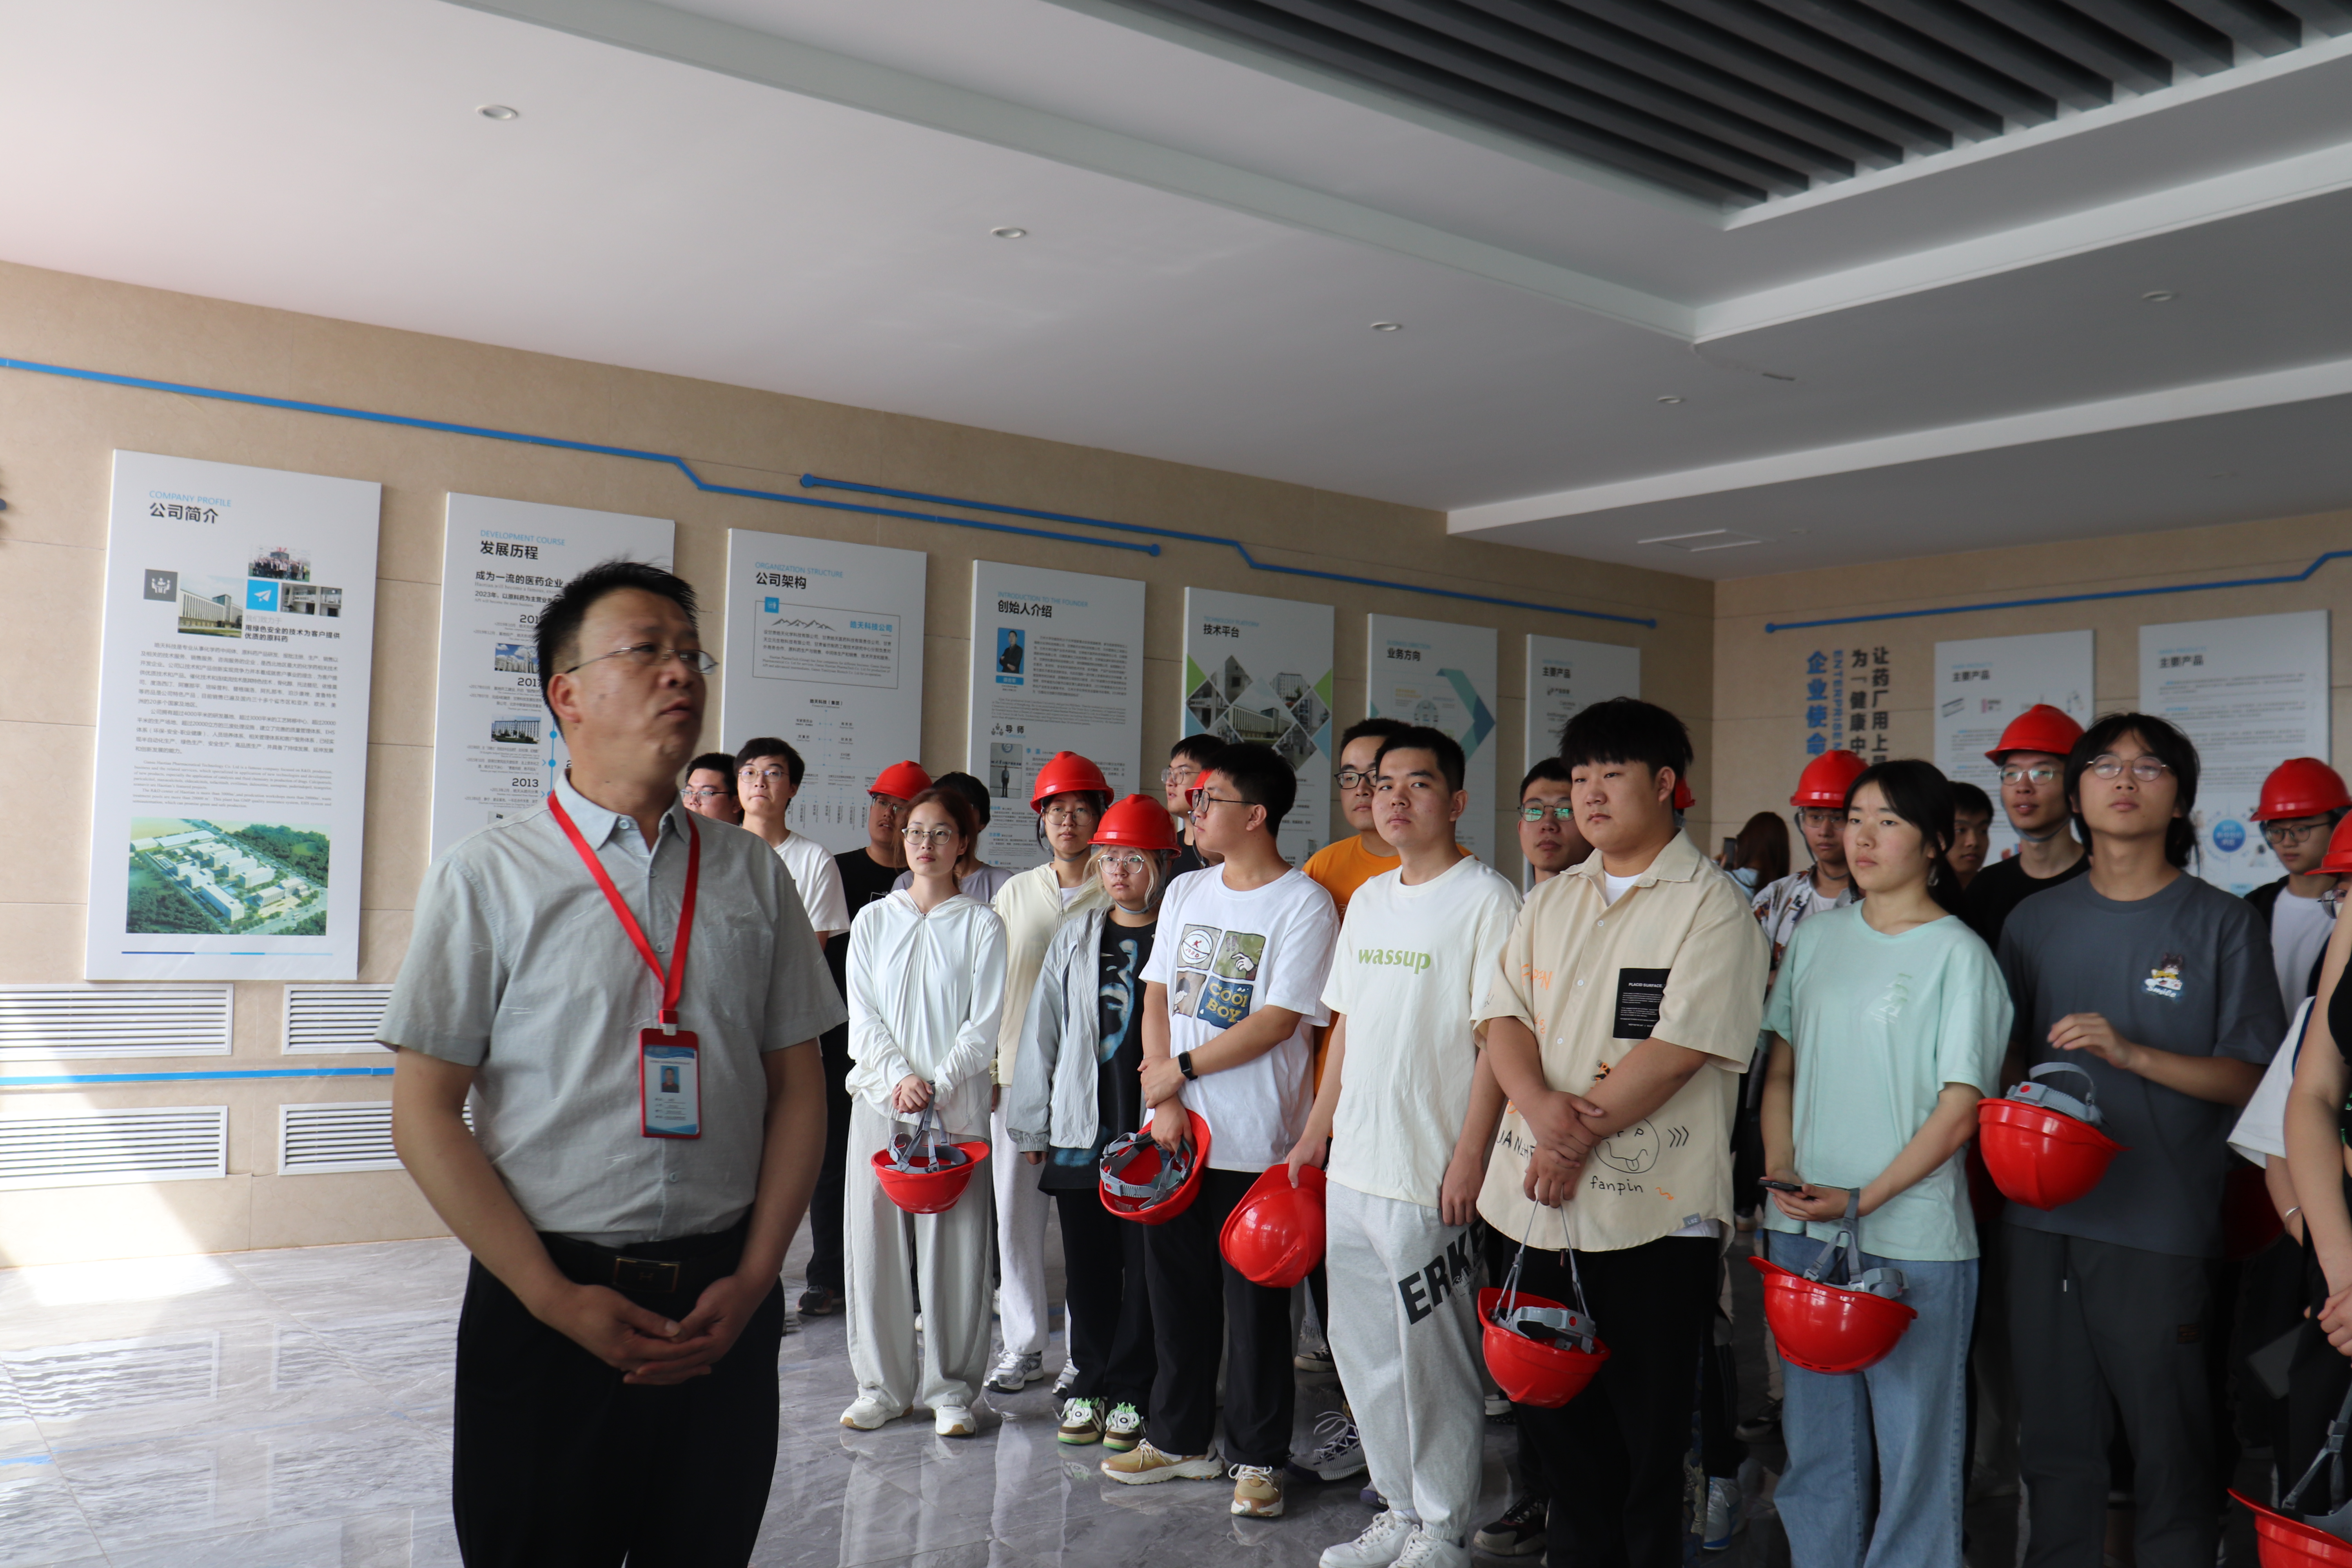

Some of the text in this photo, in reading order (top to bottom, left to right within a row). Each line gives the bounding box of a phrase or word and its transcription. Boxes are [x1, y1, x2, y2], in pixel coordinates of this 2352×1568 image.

[149, 490, 231, 507] COMPANY PROFILE
[149, 501, 219, 524] 公司简介
[480, 530, 565, 546] DEVELOPMENT COURSE
[480, 540, 539, 560] 发展历程
[755, 562, 843, 578] ORGANIZATION STRUCTURE
[475, 570, 564, 588] 成为一流的医药企业
[756, 572, 807, 590] 公司架构
[998, 599, 1052, 618] 创始人介绍
[520, 614, 539, 624] 201
[245, 624, 340, 639] 用绿色安全的技术为客户提供
[245, 632, 288, 642] 优质的原料药
[1203, 623, 1239, 638] 技术平台
[1387, 648, 1421, 662] 业务方向
[1952, 670, 1990, 682] 主要产品
[1806, 650, 1828, 755] 企业使命
[512, 778, 539, 788] 2013
[1358, 948, 1431, 975] wassup
[2145, 985, 2177, 998] Smile
[1205, 998, 1242, 1023] BOY
[1590, 1175, 1644, 1196] fanpin
[1398, 1217, 1486, 1325] ERKE
